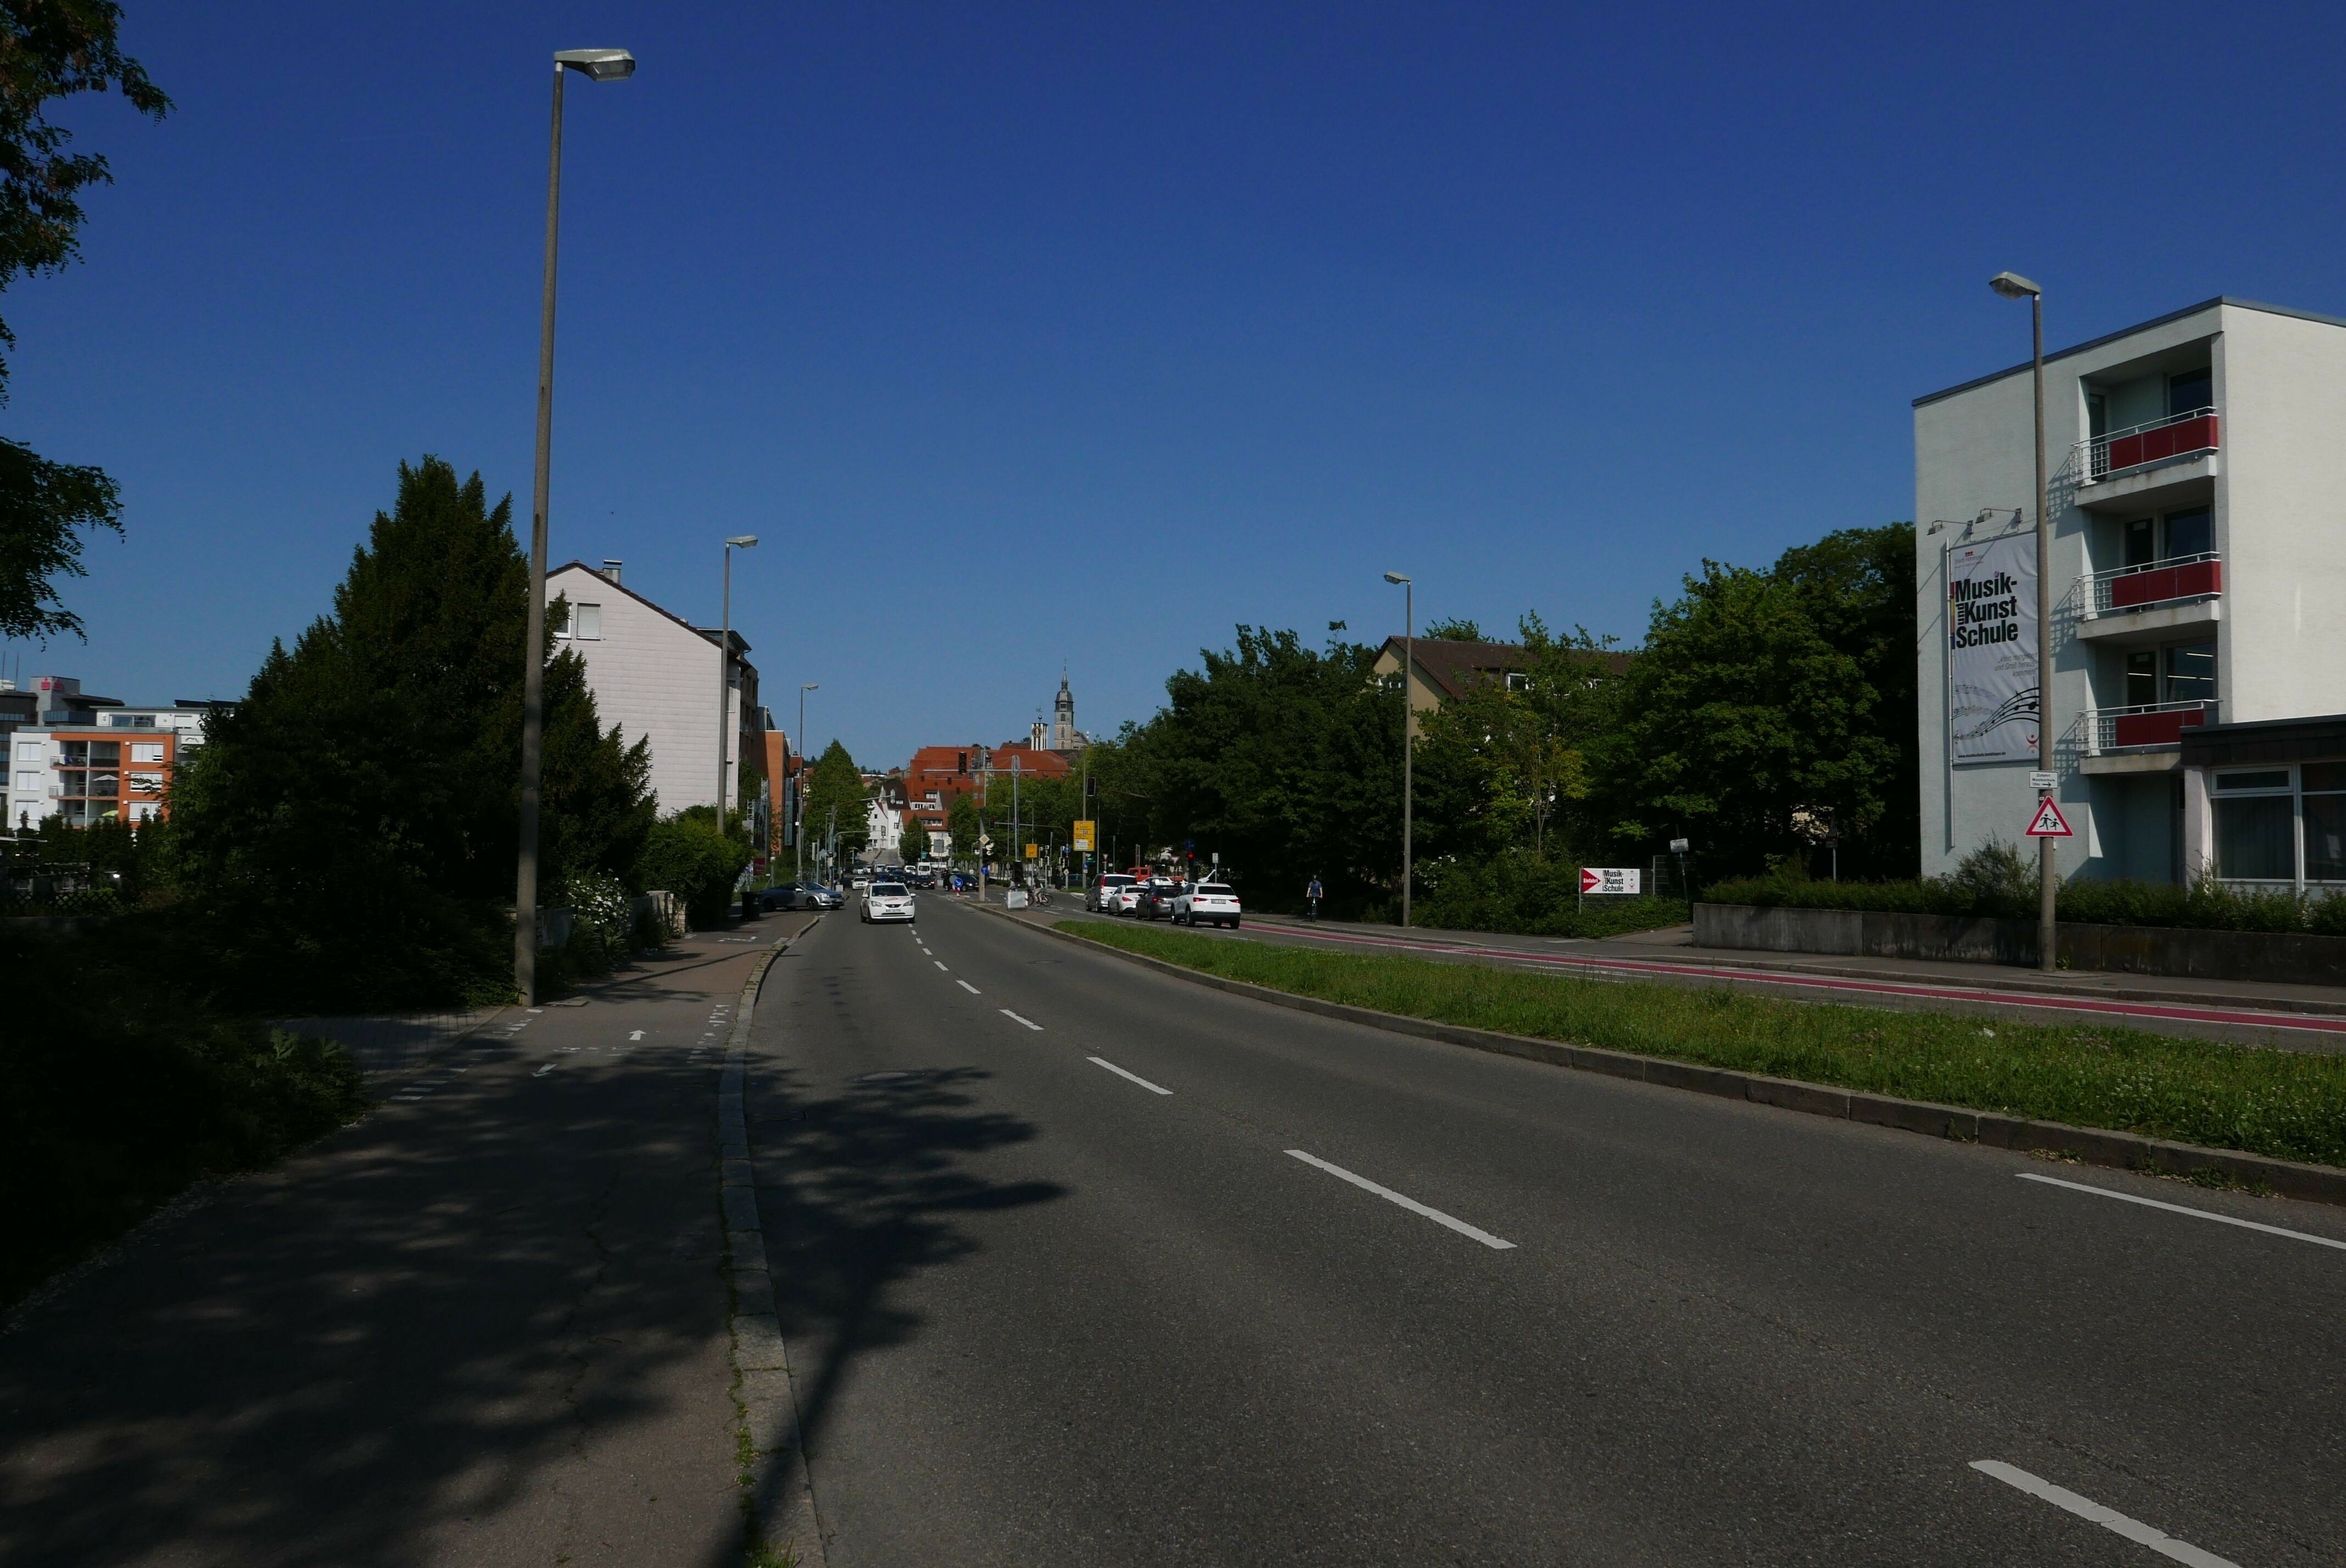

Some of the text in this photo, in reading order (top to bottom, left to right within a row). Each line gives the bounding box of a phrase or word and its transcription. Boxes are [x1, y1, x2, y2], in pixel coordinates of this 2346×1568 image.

[1955, 570, 2018, 602] Musik-
[1956, 603, 1964, 625] und
[1964, 596, 2018, 624] Kunst
[1956, 619, 2018, 648] Schule
